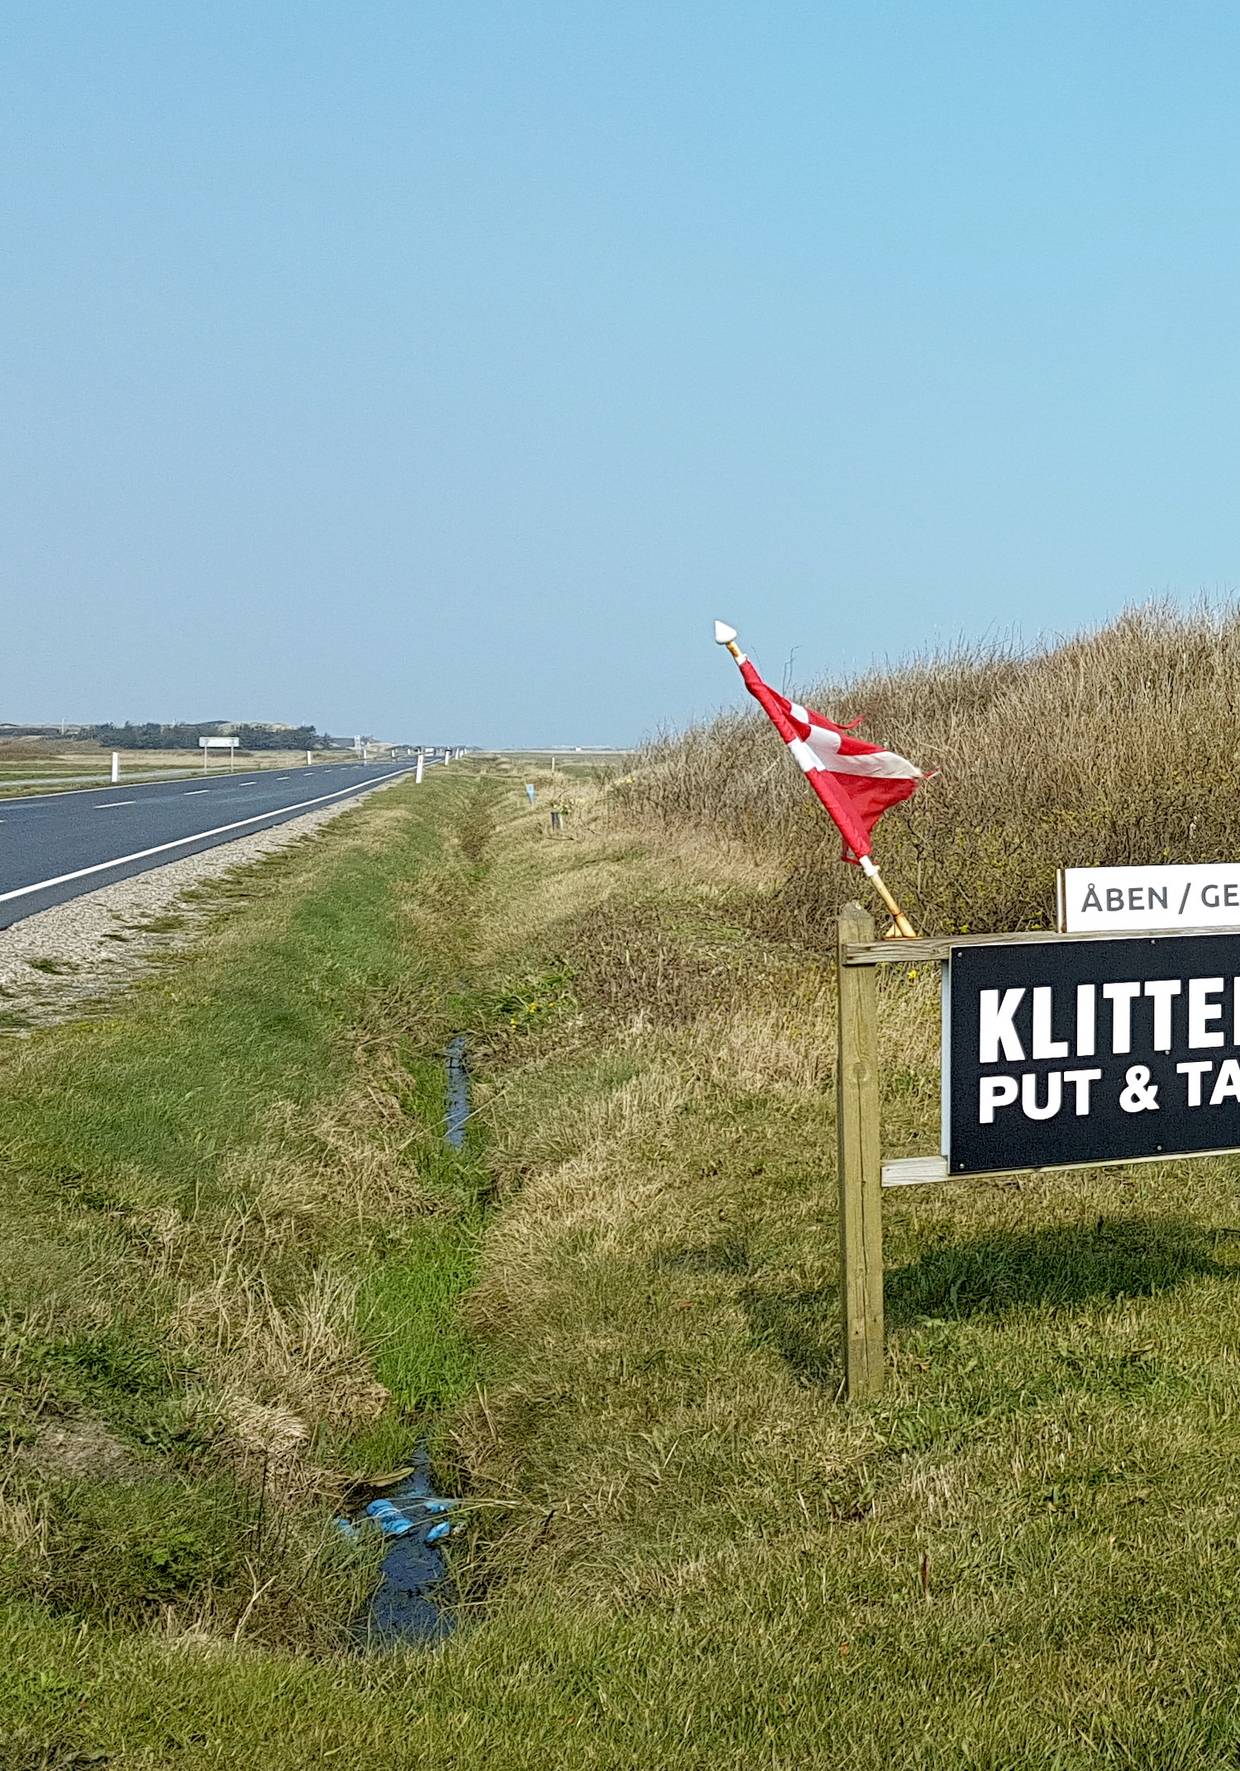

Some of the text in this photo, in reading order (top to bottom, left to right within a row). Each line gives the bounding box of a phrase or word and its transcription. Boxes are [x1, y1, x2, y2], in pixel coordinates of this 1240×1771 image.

[1081, 882, 1168, 913] ÅBEN
[979, 1068, 1102, 1124] PUT
[1119, 1064, 1160, 1113] &
